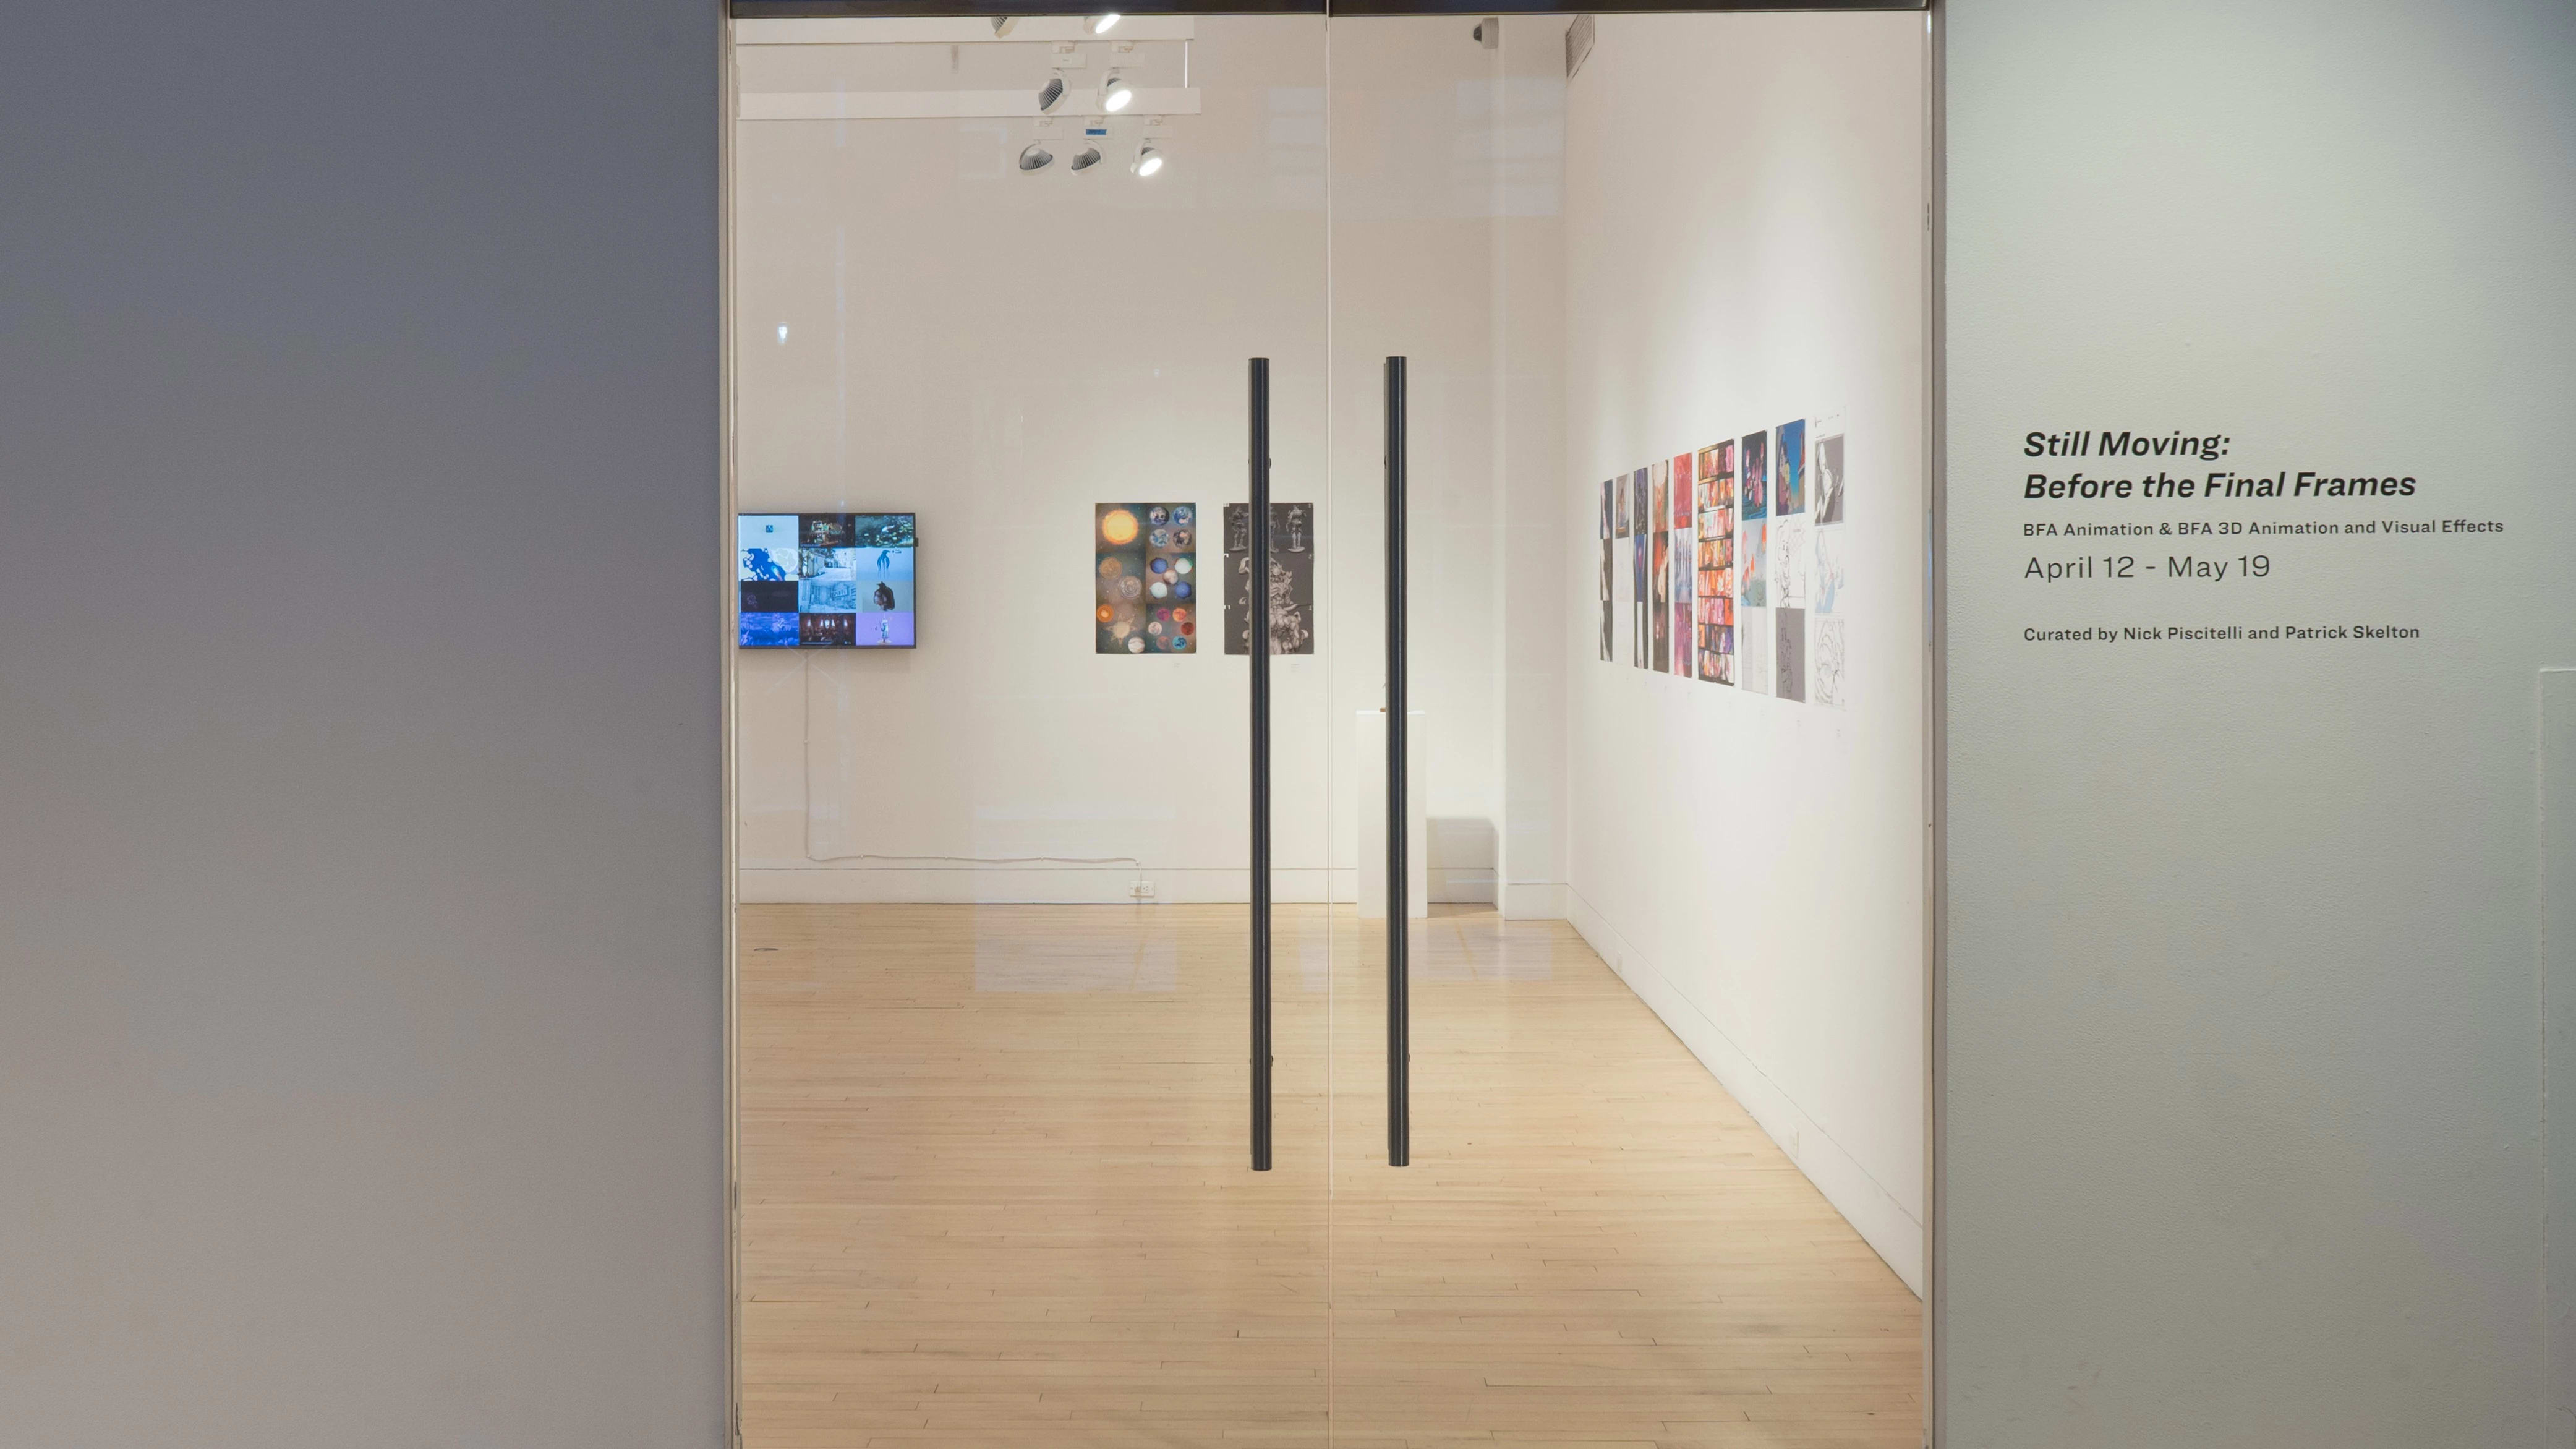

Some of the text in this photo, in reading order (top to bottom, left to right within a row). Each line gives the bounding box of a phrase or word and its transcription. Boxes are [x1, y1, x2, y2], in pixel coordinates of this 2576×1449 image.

[2023, 430, 2230, 461] Still Moving:
[2024, 471, 2416, 499] Before the Final Frames
[2024, 519, 2504, 536] BFA Animation & BFA 3D Animation and Visual Effects
[2024, 555, 2092, 583] April
[2102, 555, 2135, 578] 12
[2169, 555, 2228, 582] May
[2238, 555, 2270, 578] 19
[2024, 625, 2420, 643] Curated by Nick Piscitelli and Patrick Skelton
